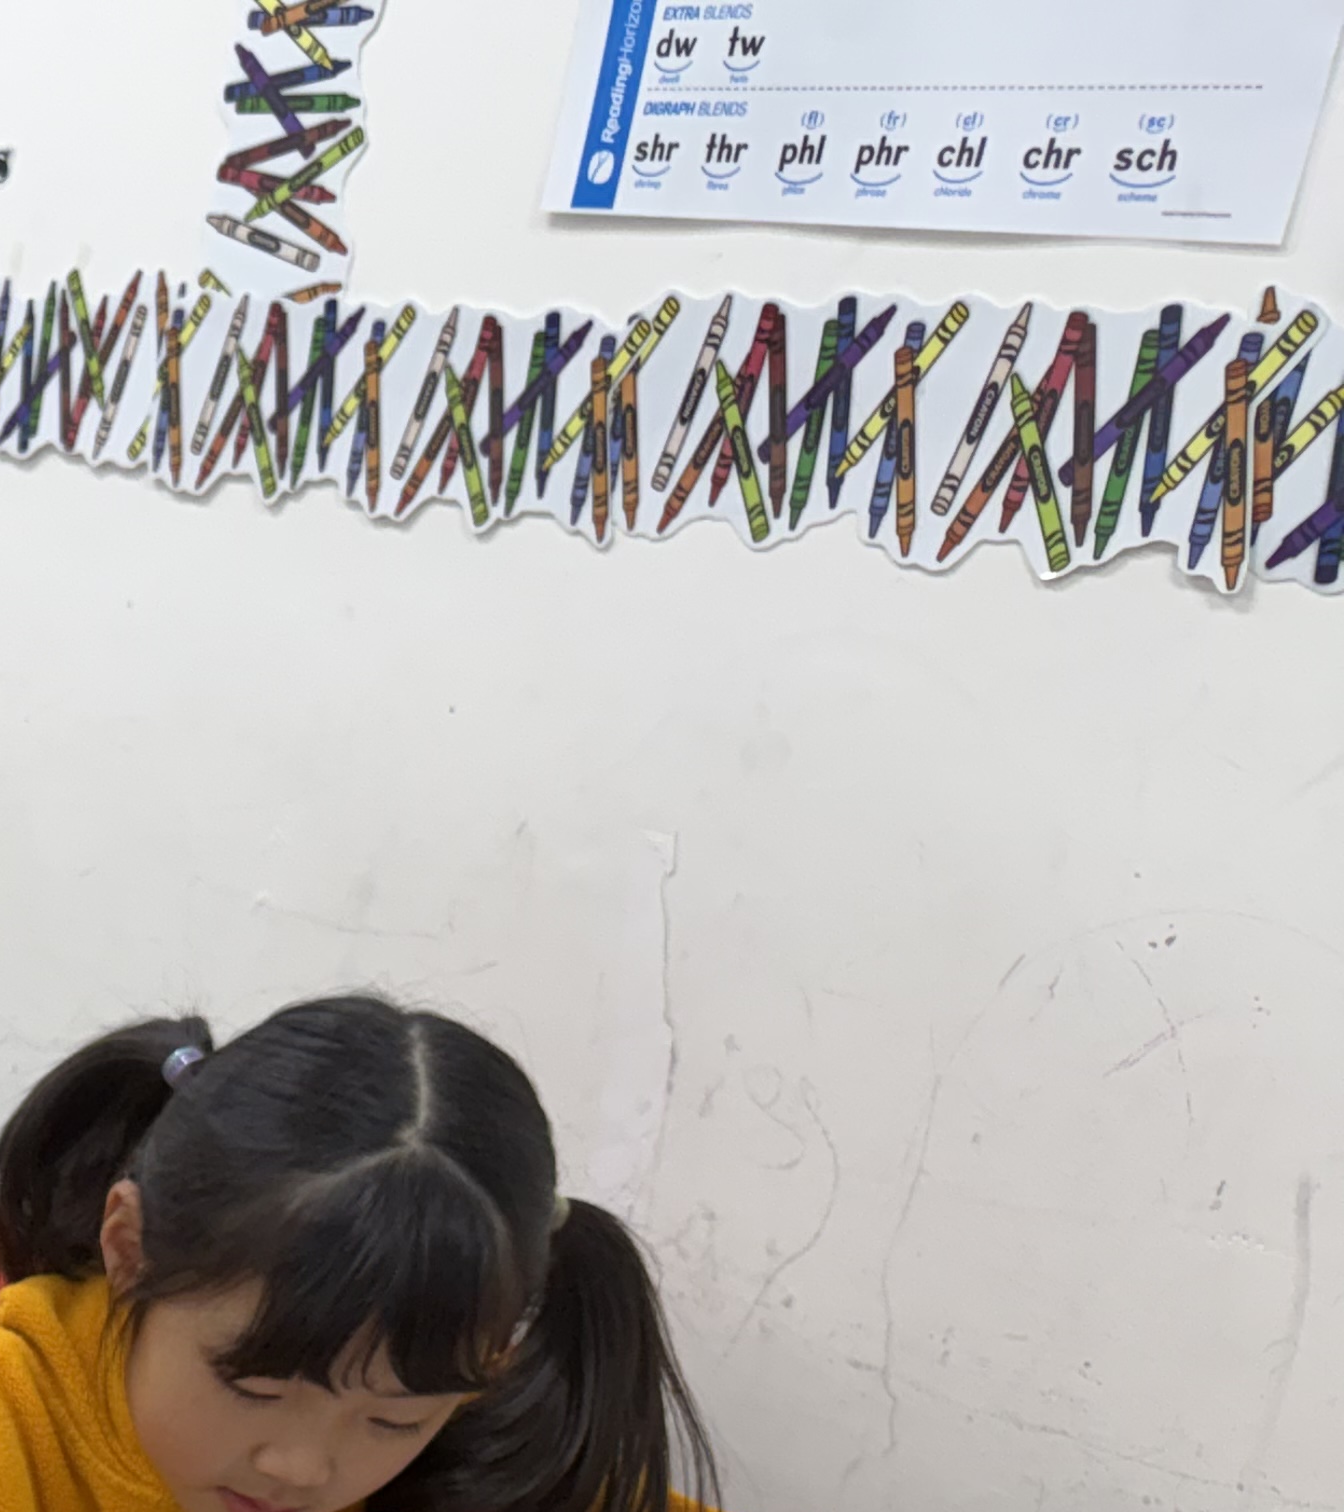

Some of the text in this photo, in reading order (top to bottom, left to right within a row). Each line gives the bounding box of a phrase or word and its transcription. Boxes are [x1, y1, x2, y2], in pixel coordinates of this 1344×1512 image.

[662, 4, 753, 21] EXTRA BLENDS
[656, 26, 766, 58] dw tw
[600, 0, 643, 143] ReadingHorizo
[643, 101, 748, 117] DIGRAPH BLENDS
[879, 110, 907, 131] (fr)
[955, 112, 984, 131] (cl)
[1046, 113, 1079, 133] (cr)
[1139, 114, 1174, 134] (sc)
[633, 132, 1177, 174] shr thr phl phr chl chr sch
